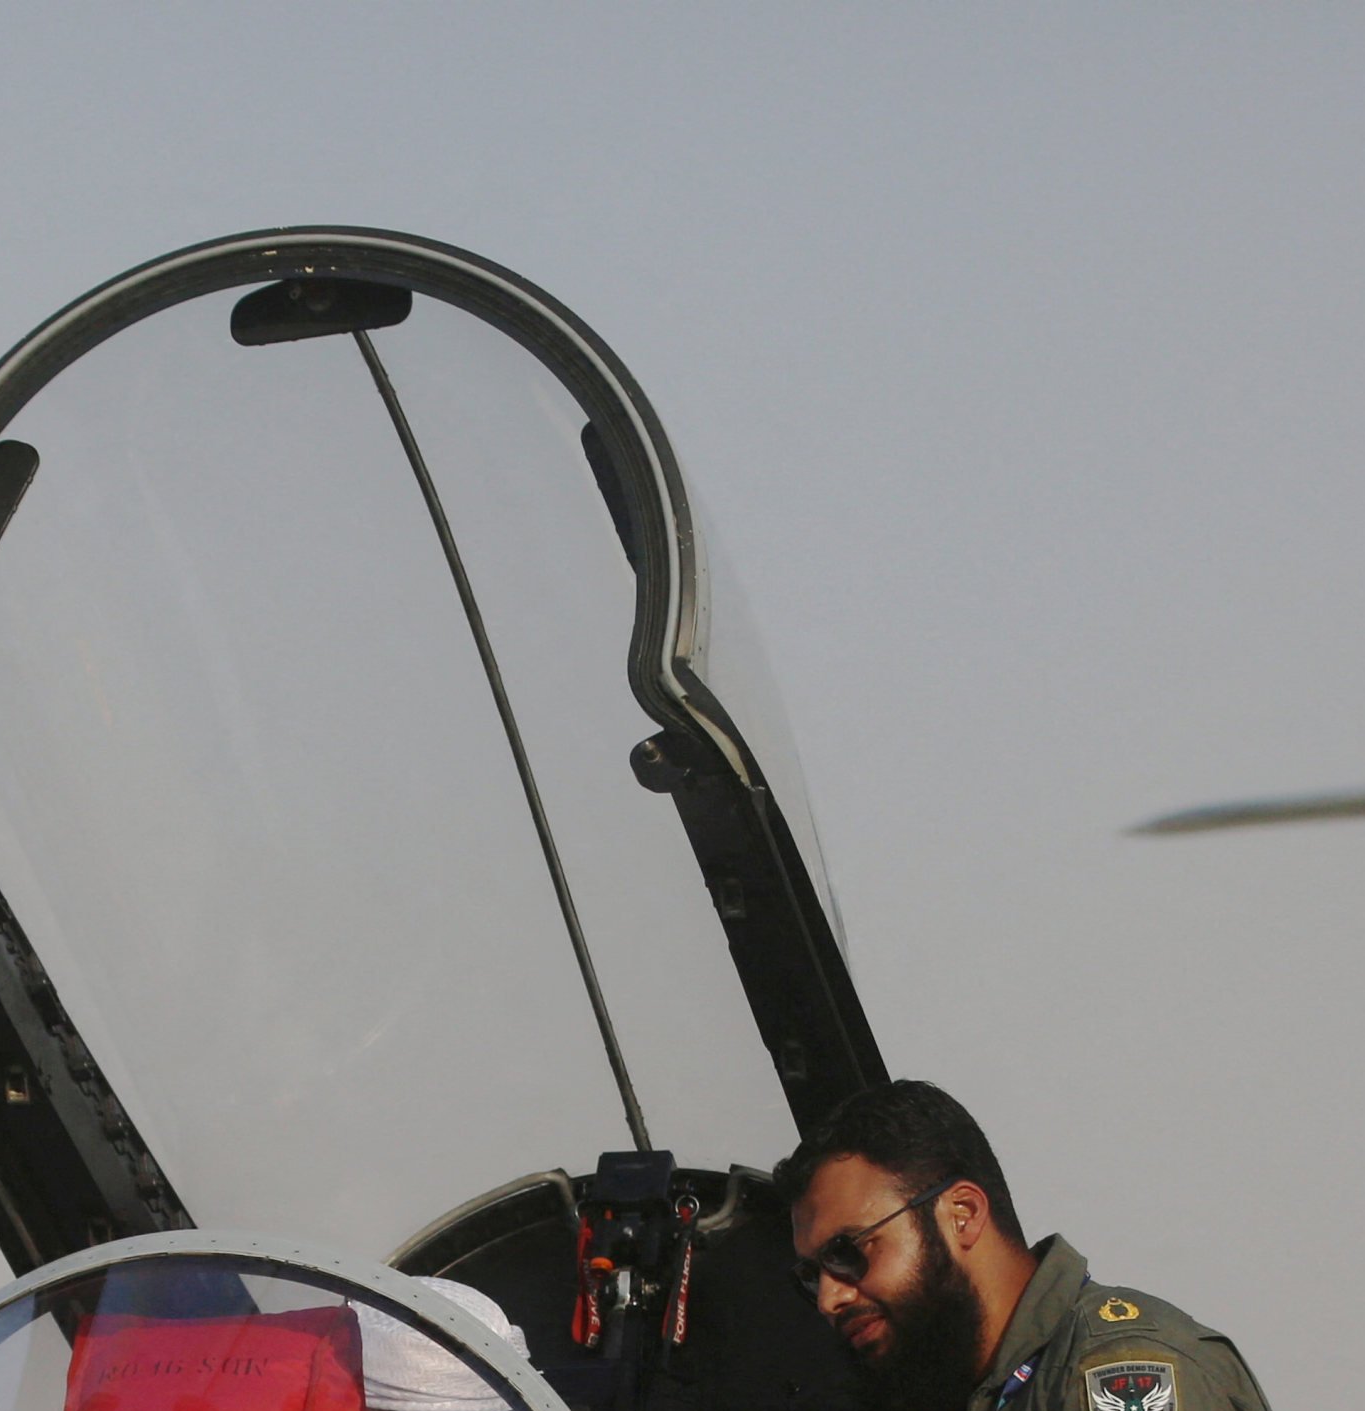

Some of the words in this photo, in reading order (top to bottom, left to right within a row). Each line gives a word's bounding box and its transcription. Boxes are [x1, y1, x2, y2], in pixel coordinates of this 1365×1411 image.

[1147, 1365, 1166, 1373] TEAM
[1111, 1377, 1128, 1392] JF
[1137, 1376, 1153, 1388] 17
